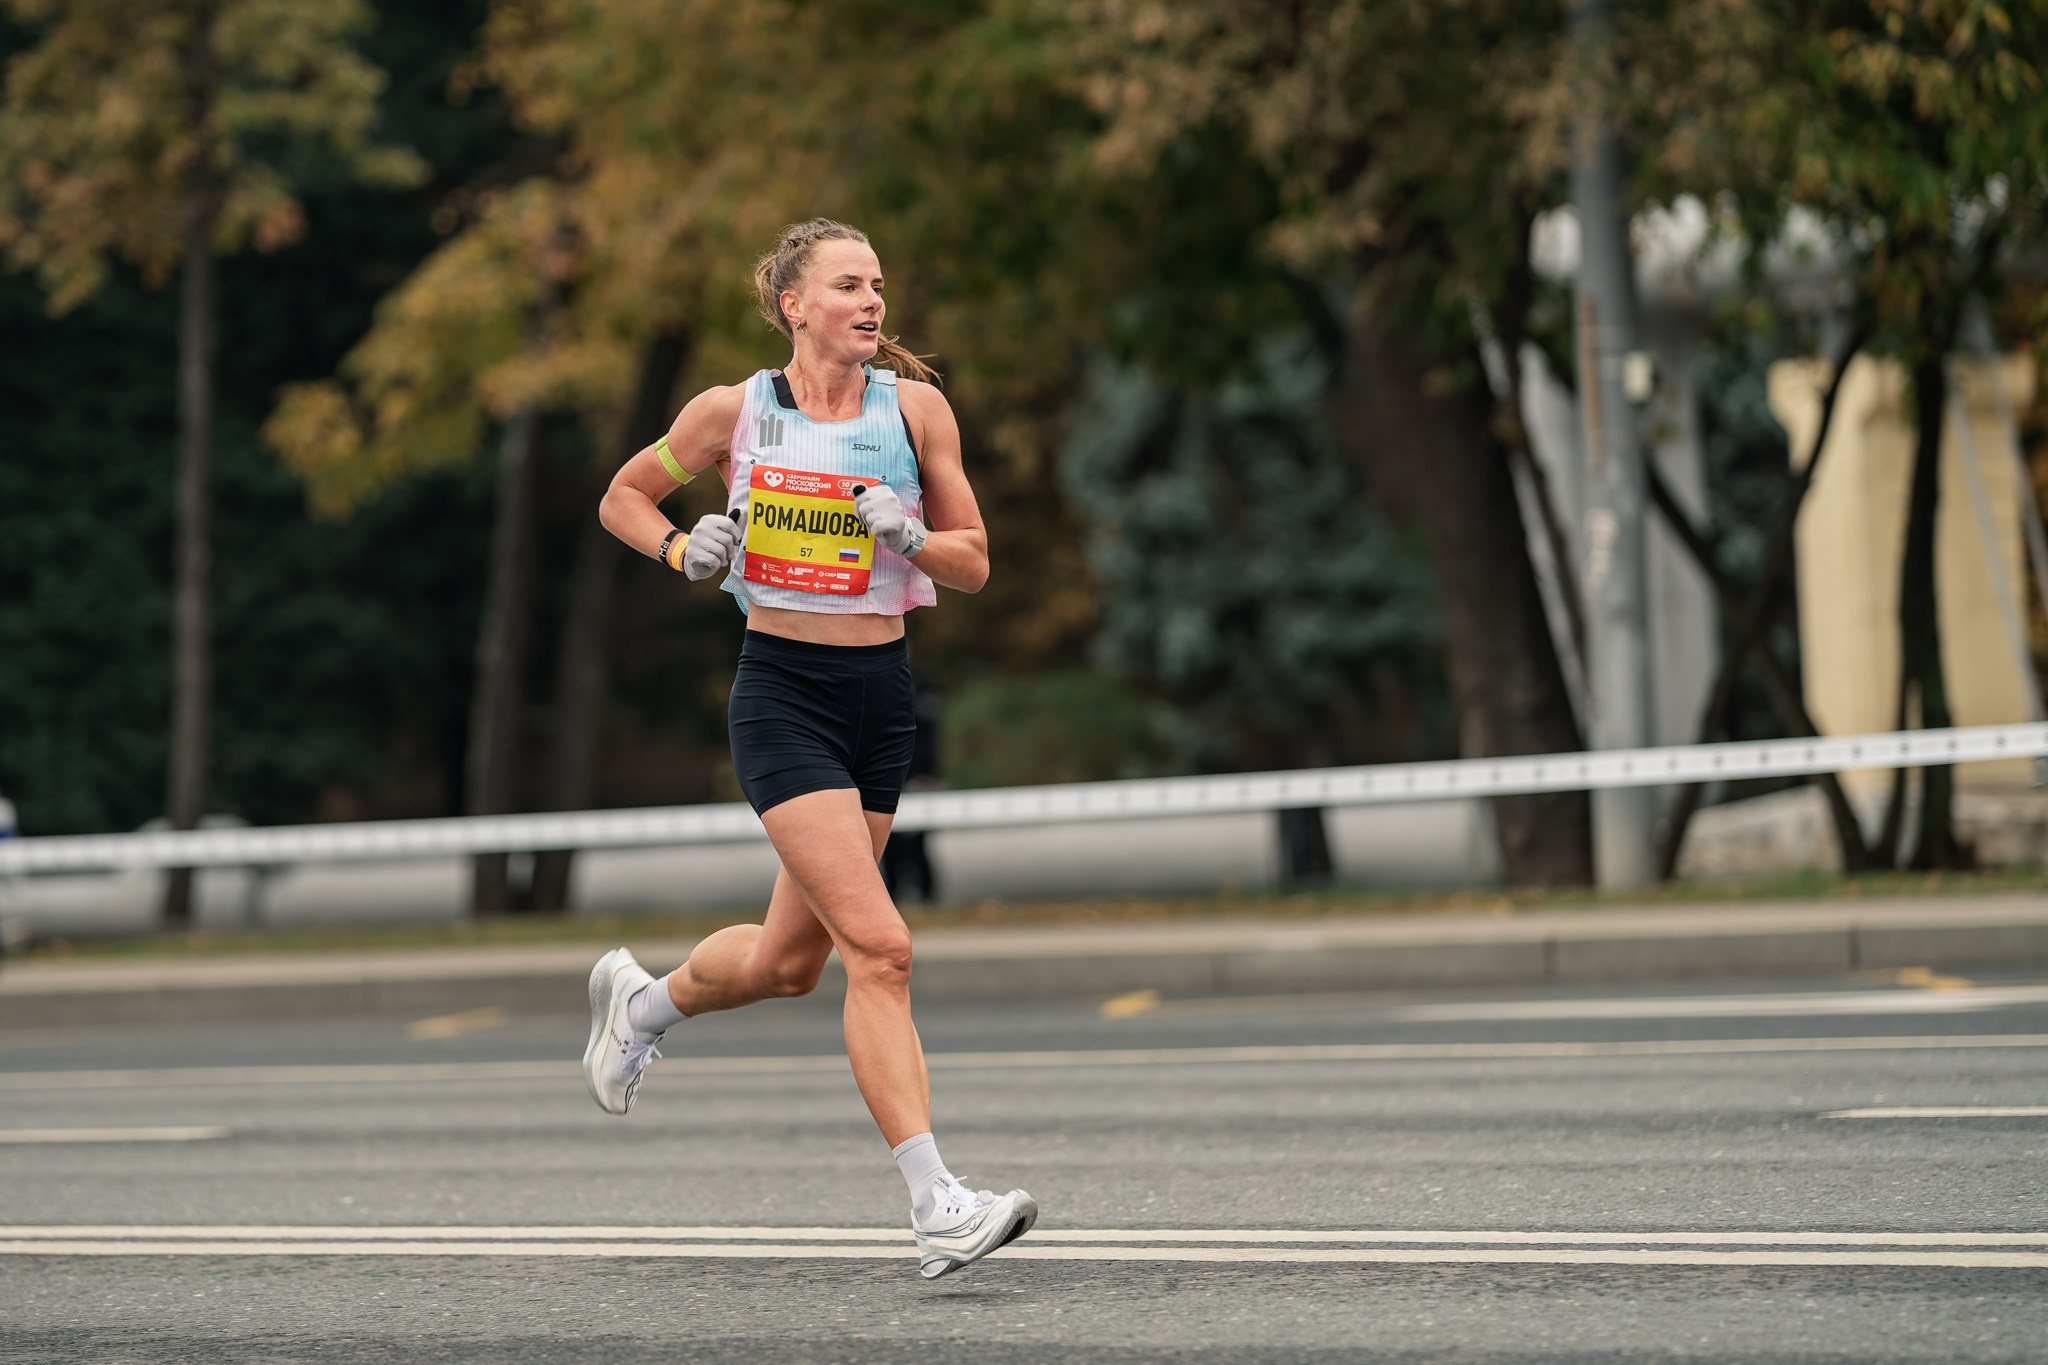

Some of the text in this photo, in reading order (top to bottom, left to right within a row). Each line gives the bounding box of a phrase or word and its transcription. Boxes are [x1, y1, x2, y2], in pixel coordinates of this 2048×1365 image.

[852, 443, 881, 452] SONU
[787, 473, 820, 482] СБЕРПРАЙМ
[786, 479, 831, 489] МОСКОВСКИЙ
[785, 485, 819, 494] МАРАФОН
[753, 502, 869, 539] РОМАШОВА
[800, 548, 813, 557] 57
